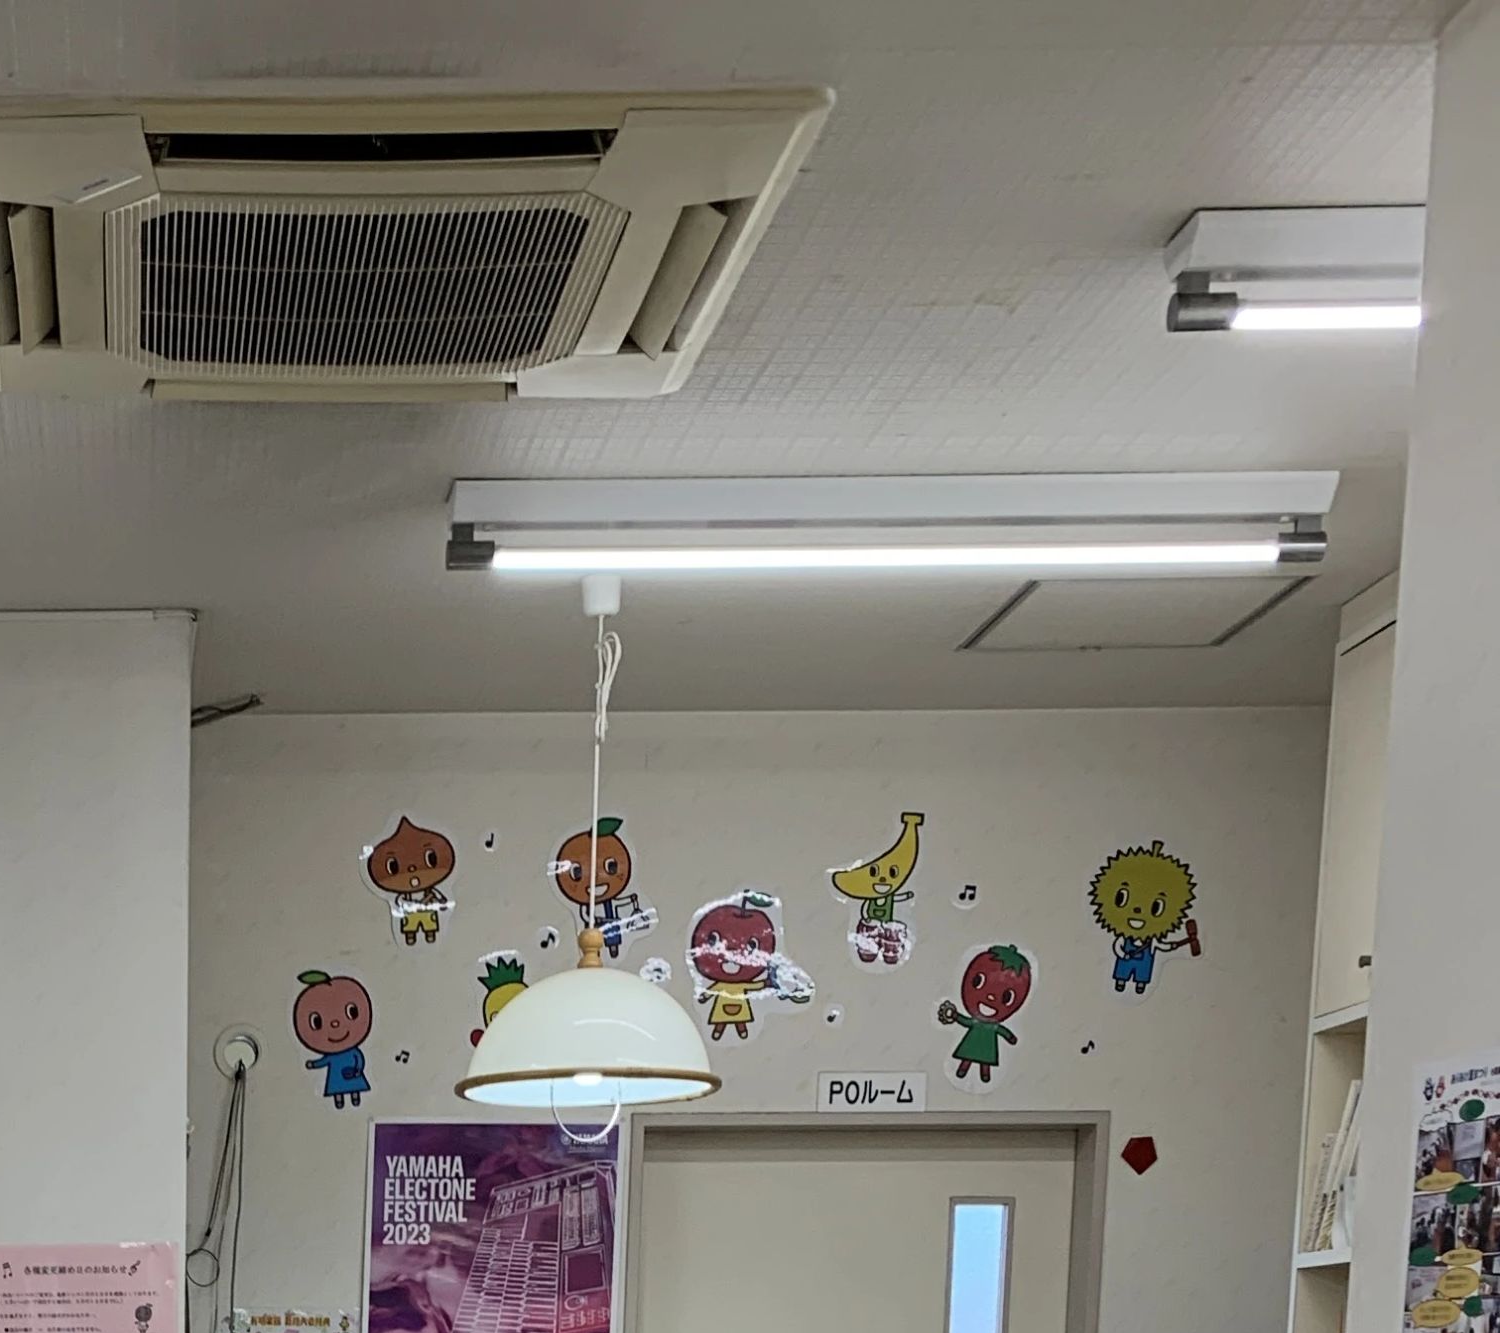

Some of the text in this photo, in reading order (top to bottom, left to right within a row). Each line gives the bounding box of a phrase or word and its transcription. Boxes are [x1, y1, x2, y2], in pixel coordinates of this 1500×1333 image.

[828, 1079, 914, 1105] POルーム
[385, 1155, 464, 1178] YAMAHA
[383, 1178, 477, 1200] ELECTONE
[383, 1201, 468, 1223] FESTIVAL
[382, 1223, 432, 1246] 2023
